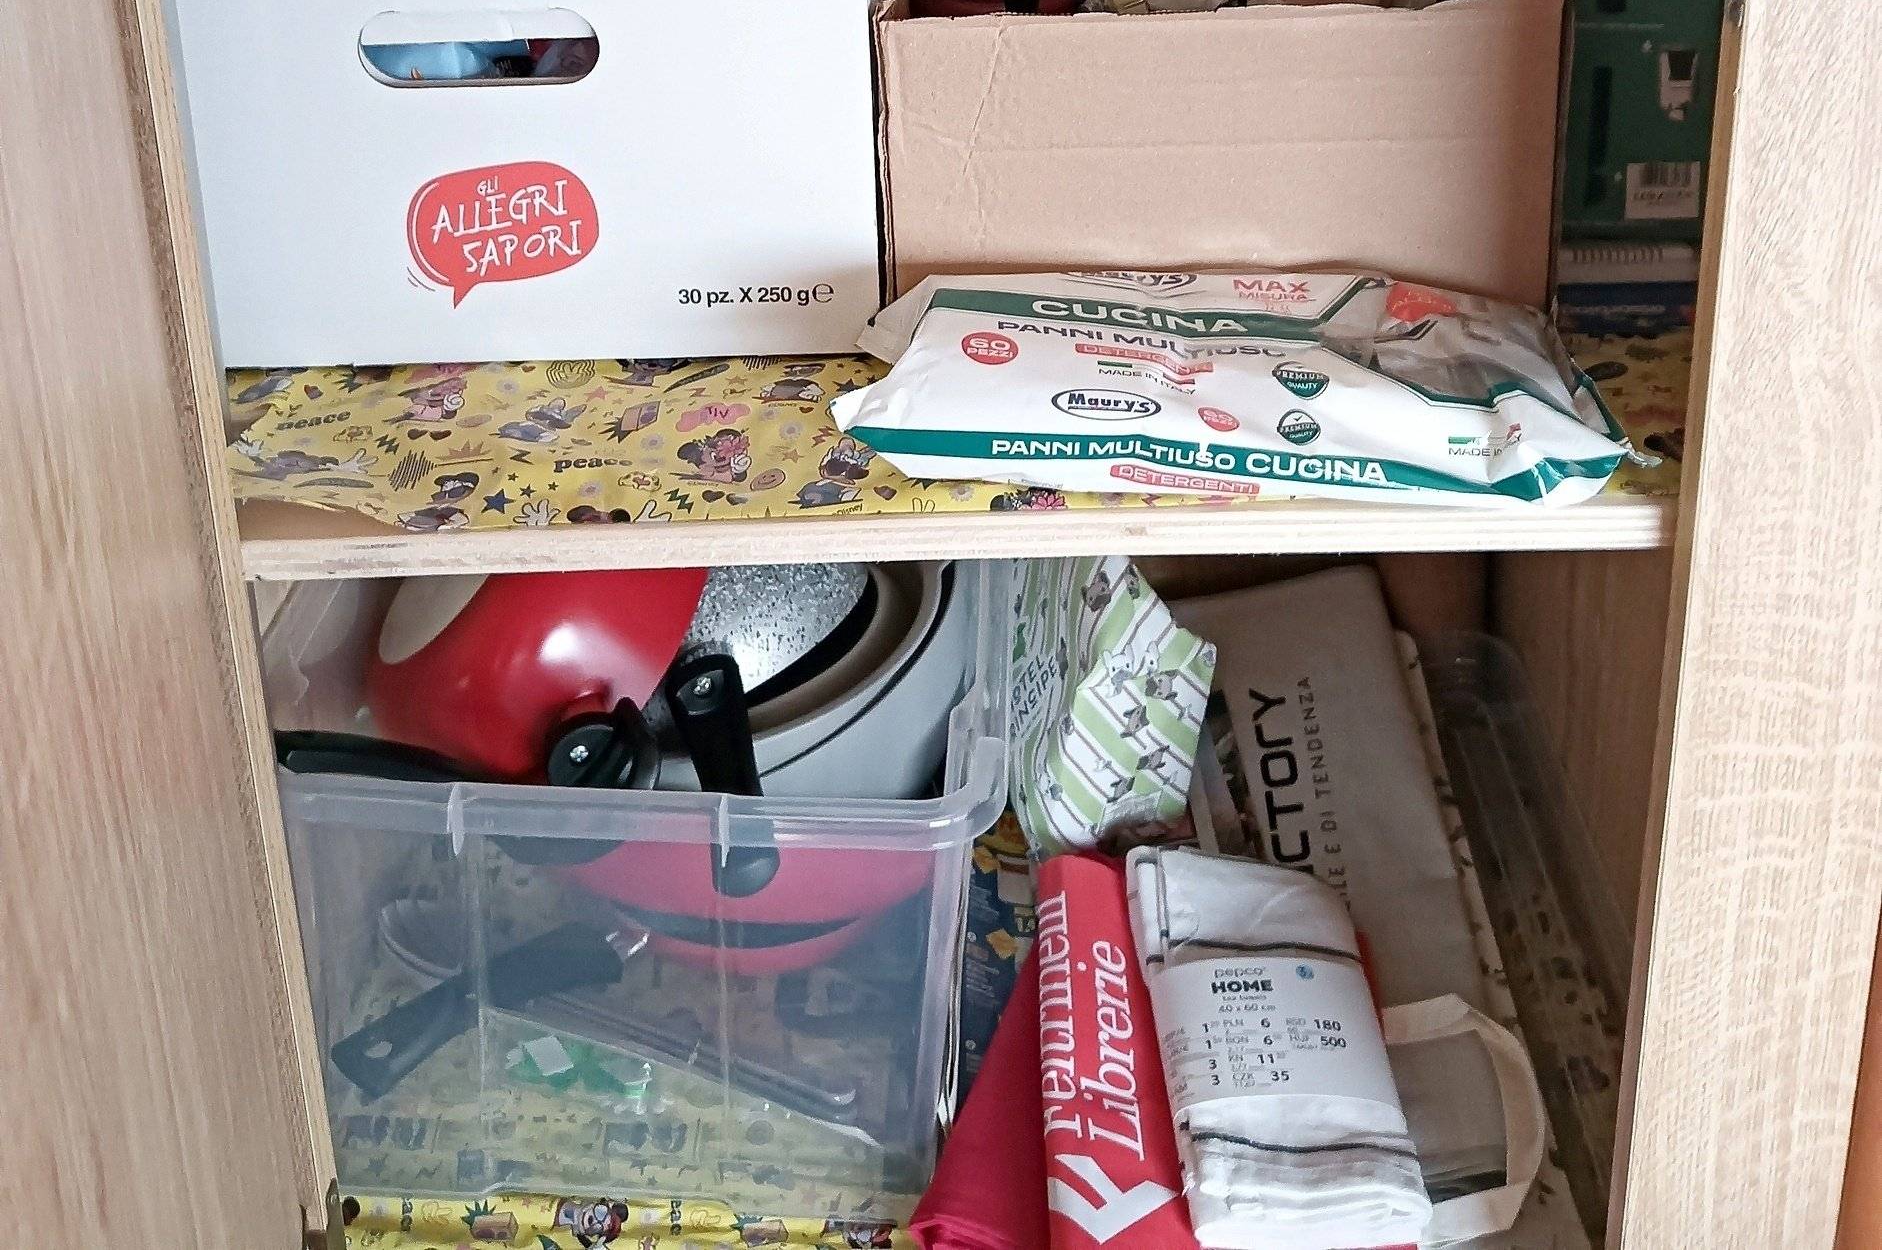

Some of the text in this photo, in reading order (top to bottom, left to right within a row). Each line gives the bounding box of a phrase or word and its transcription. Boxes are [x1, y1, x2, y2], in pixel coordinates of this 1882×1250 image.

[477, 175, 499, 196] GLI
[431, 179, 568, 245] ALLEGRI
[462, 219, 582, 277] SAPORI
[1233, 278, 1312, 293] MAX
[678, 288, 702, 304] 30
[706, 291, 735, 307] pz.
[739, 287, 753, 303] X
[757, 286, 792, 303] 250
[1031, 299, 1249, 333] CUCINA
[997, 320, 1103, 342] PANNI
[966, 347, 1014, 358] PEZZI
[967, 337, 1011, 351] 60
[1098, 368, 1143, 378] MADE
[1145, 372, 1159, 383] IN
[1277, 369, 1325, 381] PREMIUM
[1067, 392, 1151, 416] Maury's
[1448, 447, 1490, 457] MADE
[991, 438, 1390, 485] PANNI MULTIUSO CUCINA
[1117, 465, 1258, 494] DETERGENTI
[1297, 676, 1332, 799] TENDENZA
[1319, 810, 1338, 832] DI
[1214, 966, 1264, 979] pepco
[1211, 978, 1274, 994] HOME
[1260, 1017, 1271, 1028] 6
[1314, 1018, 1342, 1031] 180
[1077, 939, 1146, 1162] Librerie
[1263, 1035, 1274, 1045] 6
[1320, 1035, 1347, 1048] 500
[1208, 1059, 1217, 1070] 3
[1211, 1074, 1221, 1086] 3
[1271, 1070, 1290, 1082] 35
